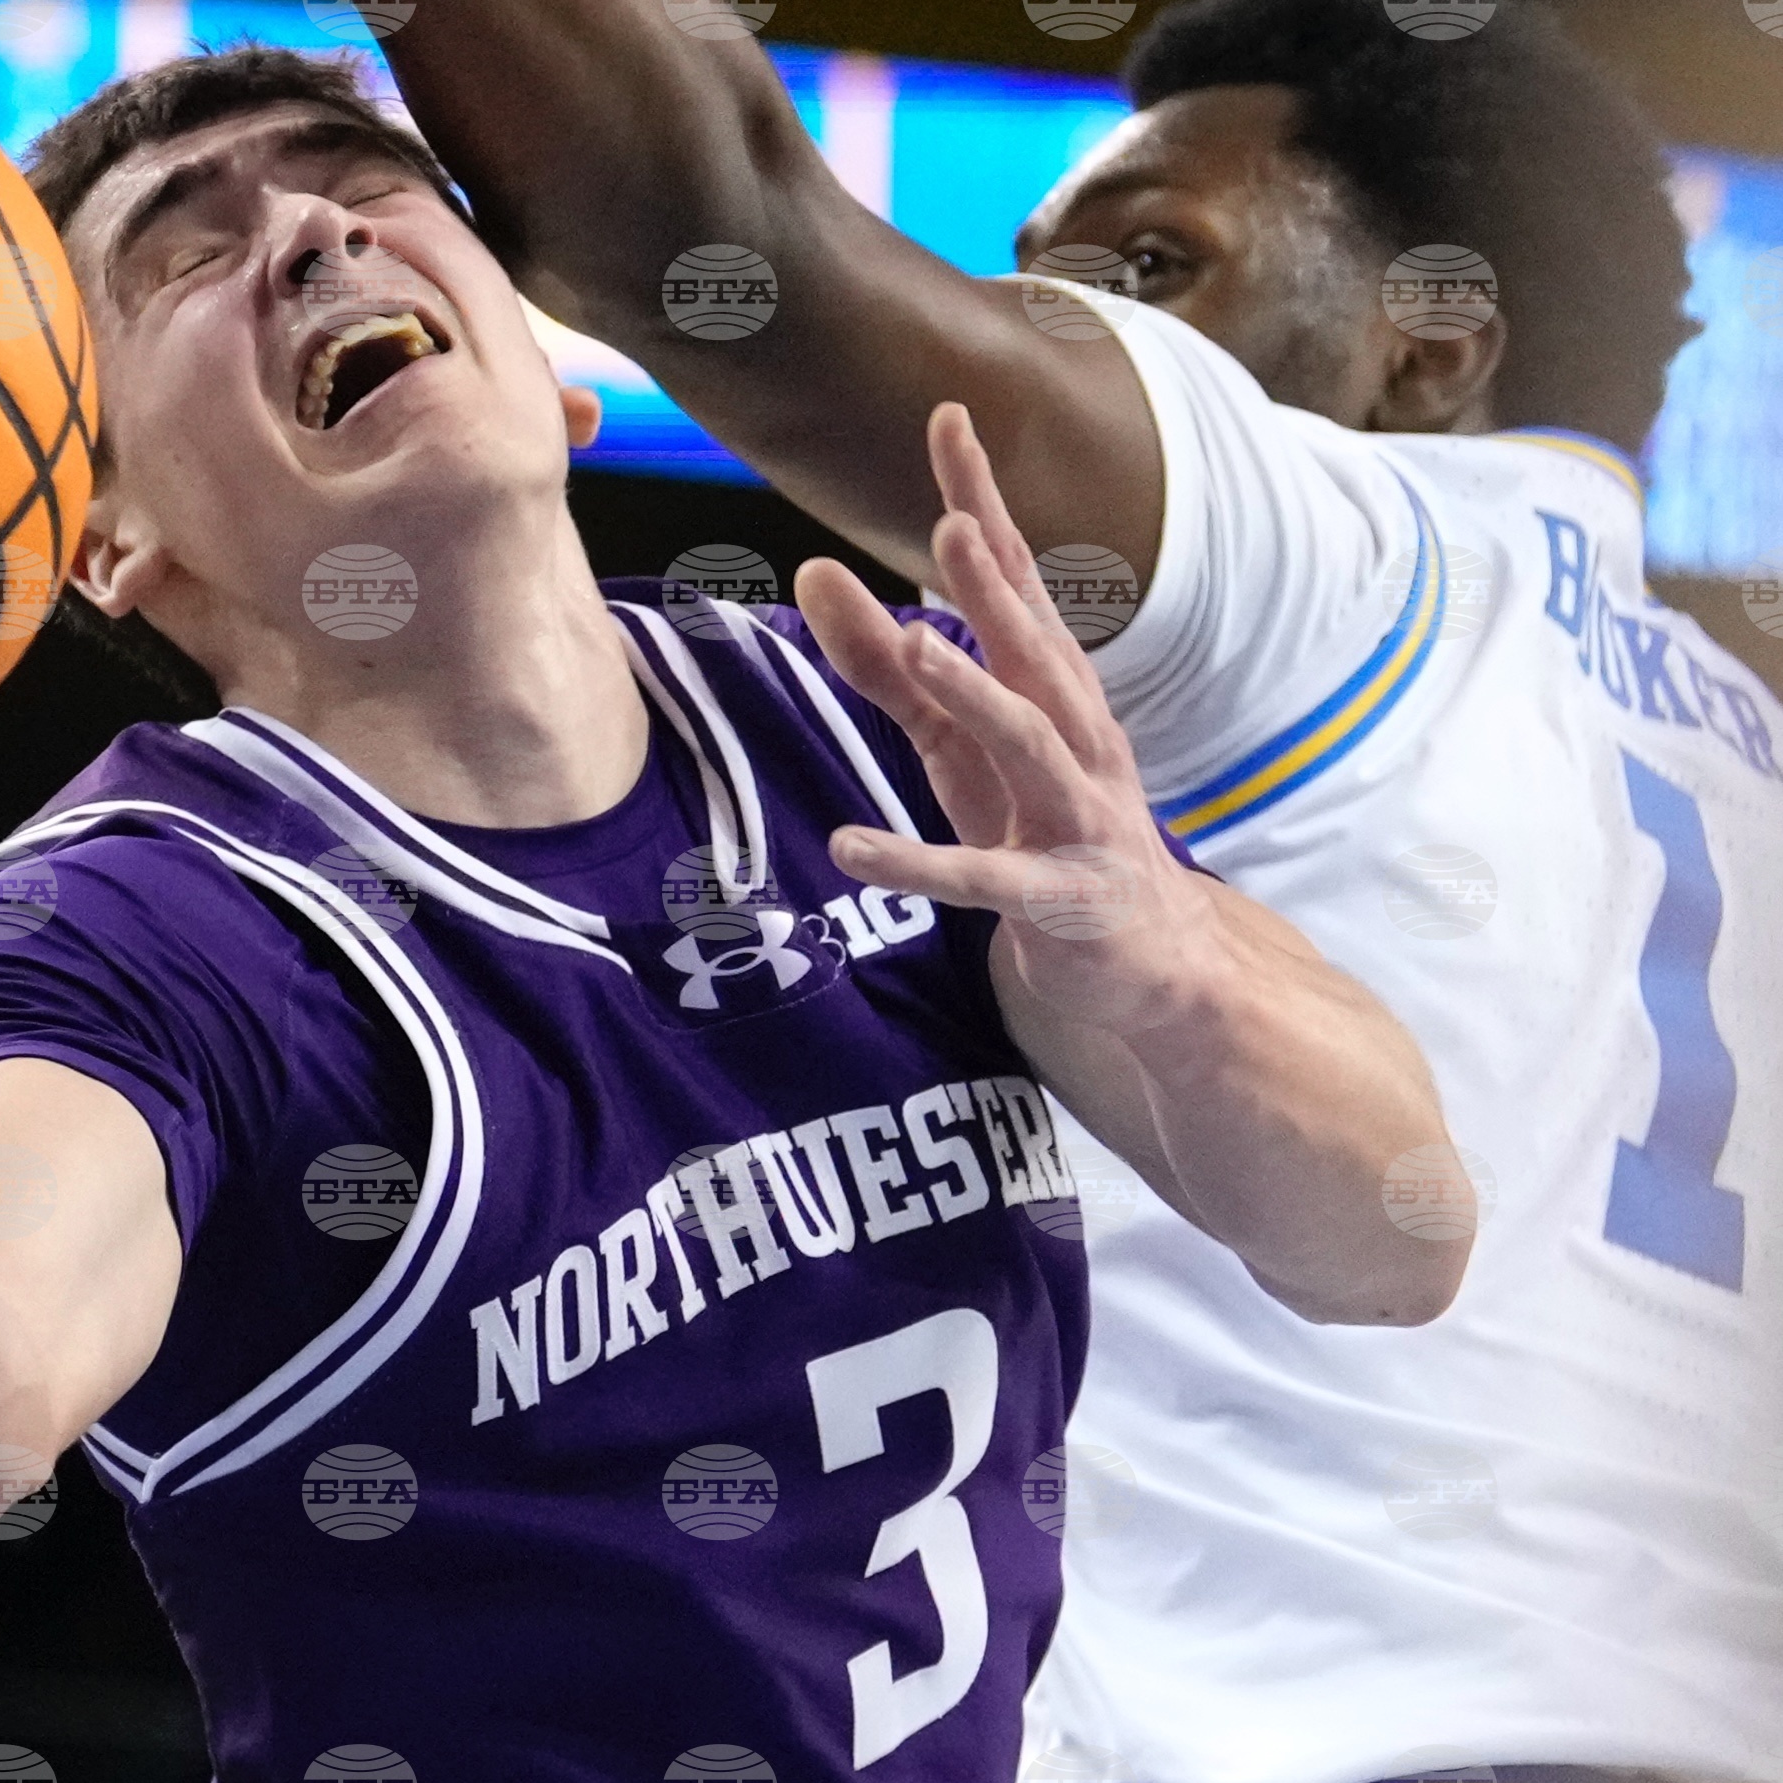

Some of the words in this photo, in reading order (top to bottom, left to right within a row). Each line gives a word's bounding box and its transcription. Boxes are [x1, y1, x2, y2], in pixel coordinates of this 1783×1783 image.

[469, 1074, 1078, 1427] NORTHWESER
[1601, 743, 1746, 1294] 1
[805, 1306, 999, 1772] 3
